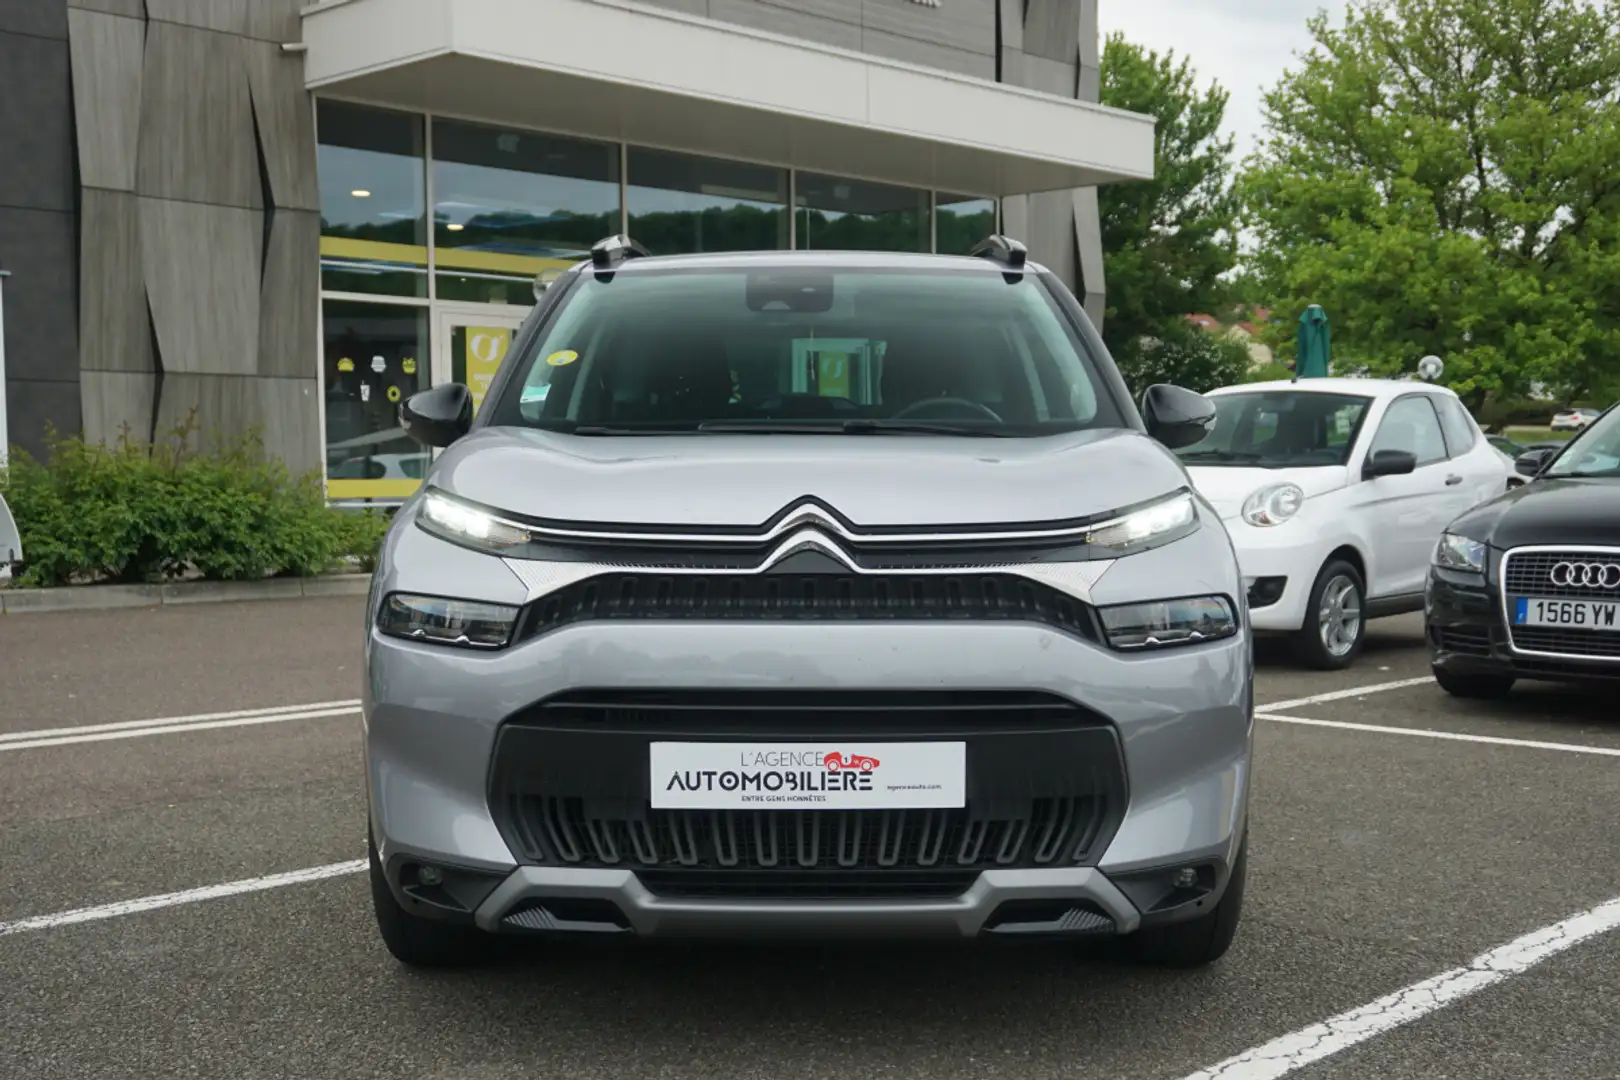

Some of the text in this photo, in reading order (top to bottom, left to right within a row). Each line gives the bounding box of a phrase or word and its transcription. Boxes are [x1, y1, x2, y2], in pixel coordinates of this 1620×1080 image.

[1536, 601, 1616, 626] 1566 YW
[741, 751, 824, 767] L'AGENCE
[787, 793, 827, 802] HONNÊTES
